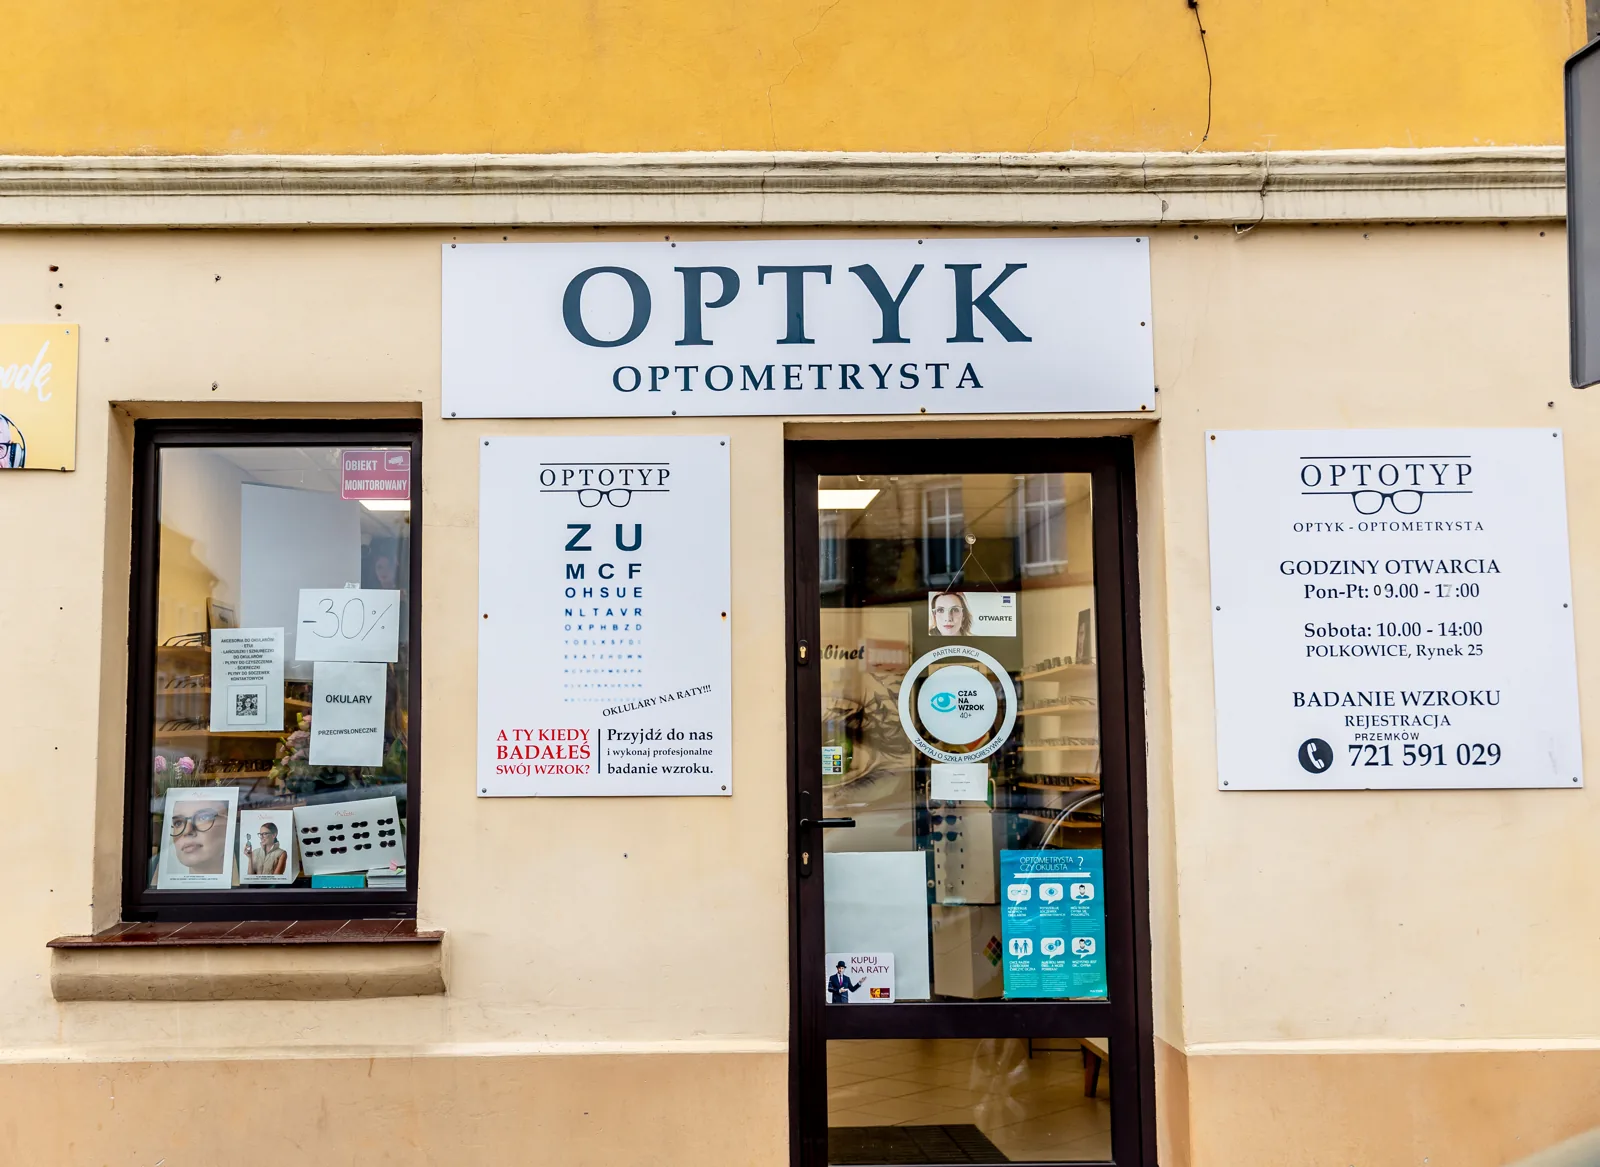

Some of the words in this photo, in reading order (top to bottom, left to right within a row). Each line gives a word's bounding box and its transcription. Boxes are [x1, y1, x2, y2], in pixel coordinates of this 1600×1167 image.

[562, 263, 1033, 349] OPTYK
[612, 363, 984, 393] OPTOMETRYSTA
[345, 460, 378, 471] OBIEKT
[539, 468, 670, 487] OPTOTYP
[1300, 463, 1473, 487] OPTOTYP
[344, 479, 408, 491] MONITOROWANY
[1293, 521, 1345, 533] OPTYK
[1358, 521, 1484, 532] OPTOMETRYSTA
[1280, 559, 1380, 576] GODZINY
[1385, 558, 1501, 574] OTWARCIA
[1304, 583, 1369, 599] Pon-Pt:
[303, 598, 393, 641] -30%
[978, 614, 1013, 622] OTWARTE
[1304, 621, 1372, 638] Sobota:
[1376, 621, 1421, 637] 10.00
[1438, 621, 1483, 637] 14:00
[932, 647, 961, 658] PARTNER
[961, 648, 980, 658] AKCJI
[1306, 644, 1412, 659] POLKOWICE,
[1416, 643, 1463, 660] Rynek
[1467, 644, 1484, 657] 25
[325, 694, 372, 705] OKULARY
[602, 697, 658, 717] OKLULARY
[658, 693, 676, 704] NA
[676, 684, 712, 700] RATY!!!
[1292, 690, 1396, 708] BADANIE
[1399, 690, 1501, 706] WZROKU
[959, 711, 972, 719] 40+
[1344, 714, 1452, 730] REJESTRACJA
[318, 727, 378, 736] PRZECIWSŁONECZNE
[497, 729, 508, 741] A
[512, 728, 534, 741] TY
[538, 728, 591, 741] KIEDY
[607, 728, 663, 745] Przyjdź
[666, 728, 685, 741] do
[688, 730, 714, 741] nas
[1354, 729, 1420, 741] PRZEMKÓW
[496, 741, 591, 760] BADAŁEŚ
[613, 748, 651, 758] wykonaj
[653, 747, 713, 758] profesjonalne
[914, 737, 937, 756] ZAPYTAJ
[943, 754, 963, 762] SZKŁA
[963, 735, 1004, 762] PROGRESYWNE
[1348, 743, 1395, 767] 721
[1402, 743, 1449, 767] 591
[1456, 742, 1502, 766] 029
[496, 763, 532, 777] SWÓJ
[534, 764, 590, 775] WZROK?
[607, 763, 658, 774] badanie
[662, 763, 714, 774] wzroku.
[1020, 855, 1074, 864] OPTOMETRYSTA
[1020, 863, 1035, 872] CZY
[1035, 863, 1068, 871] OKULISTA
[851, 956, 878, 966] KUPUJ
[851, 966, 865, 974] NA
[866, 965, 890, 974] RATY
